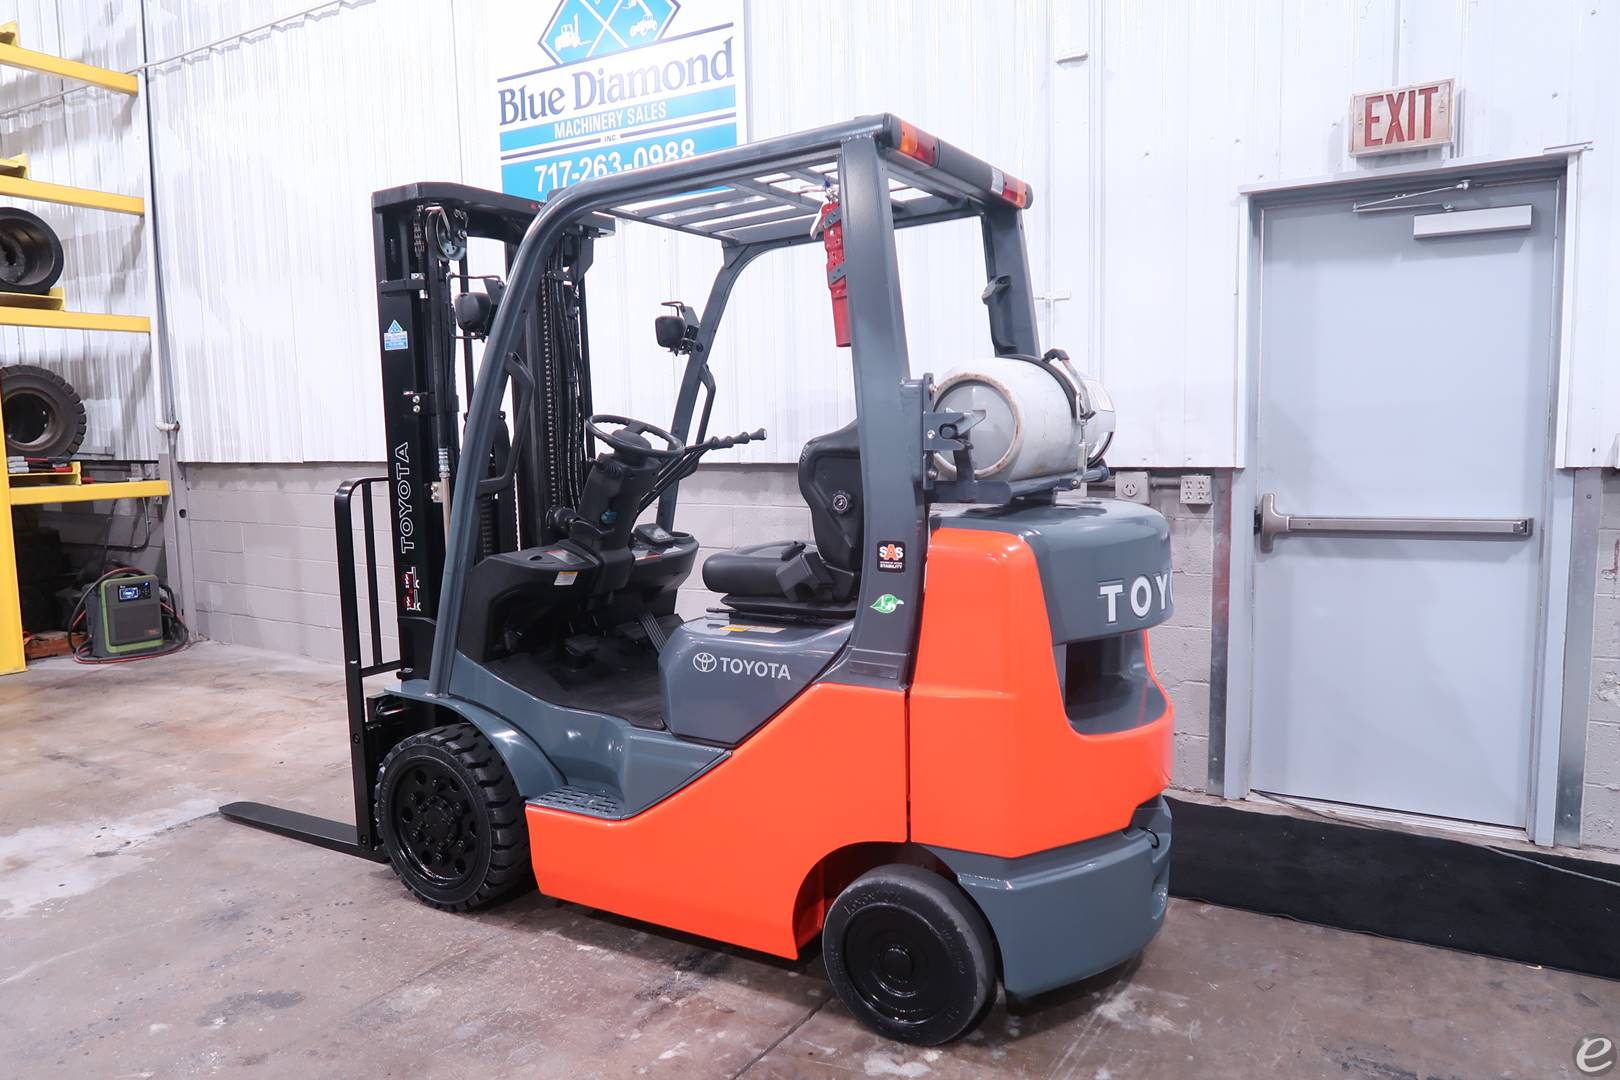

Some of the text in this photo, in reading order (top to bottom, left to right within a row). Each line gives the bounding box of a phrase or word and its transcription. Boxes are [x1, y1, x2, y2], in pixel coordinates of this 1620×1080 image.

[498, 36, 735, 126] Blue Diamond
[554, 101, 667, 139] MACHINERY SALES
[1364, 86, 1439, 147] EXIT
[395, 441, 415, 554] TOYOTA
[879, 543, 904, 561] SAS
[1100, 573, 1173, 622] TOY
[719, 657, 791, 680] TOYOTA
